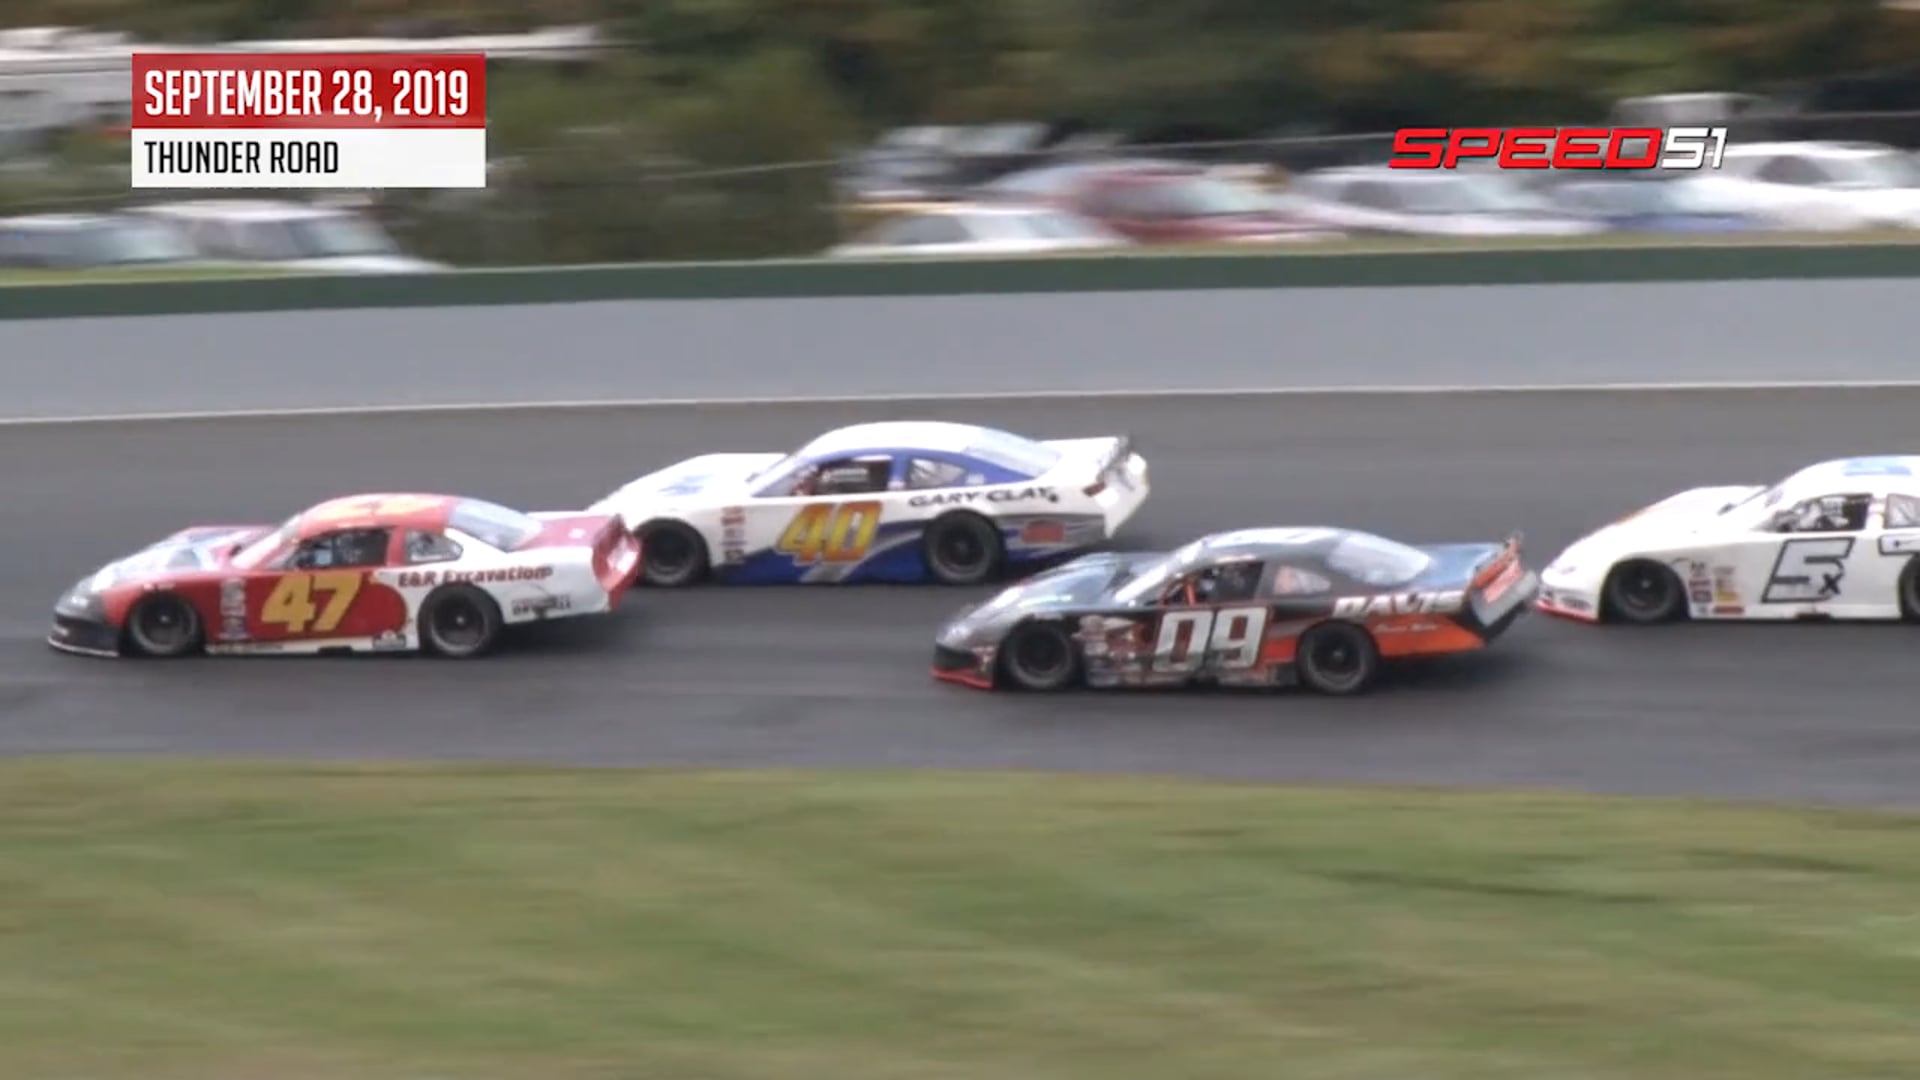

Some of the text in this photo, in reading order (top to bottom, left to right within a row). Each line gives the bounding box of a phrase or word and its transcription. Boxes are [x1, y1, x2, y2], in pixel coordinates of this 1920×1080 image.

[909, 491, 979, 507] GARY
[776, 500, 882, 566] 40
[261, 572, 363, 632] 47
[1152, 607, 1267, 673] 09
